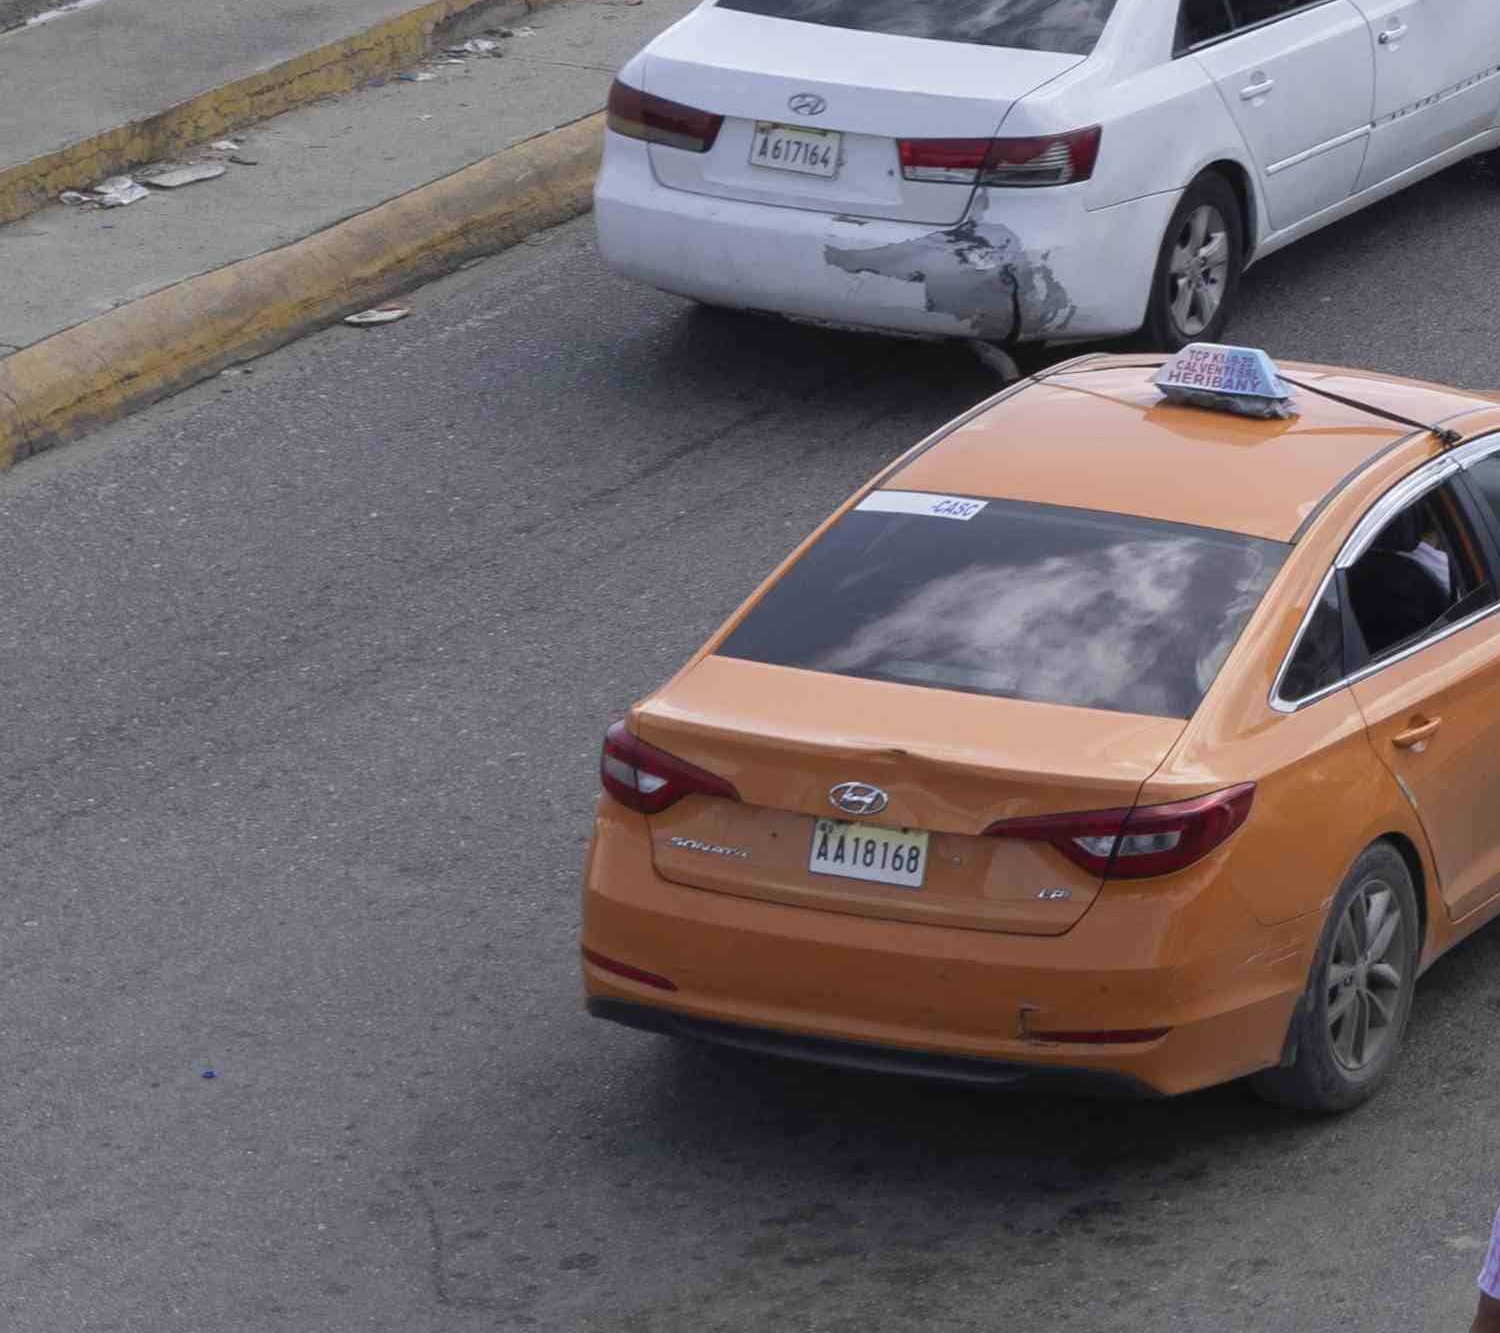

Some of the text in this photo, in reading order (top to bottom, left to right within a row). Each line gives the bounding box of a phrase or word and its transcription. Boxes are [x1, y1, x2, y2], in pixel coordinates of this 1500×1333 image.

[758, 135, 832, 168] A617164
[1168, 371, 1262, 393] HERIBANY
[669, 835, 748, 859] SONATA
[815, 833, 921, 875] AA18168
